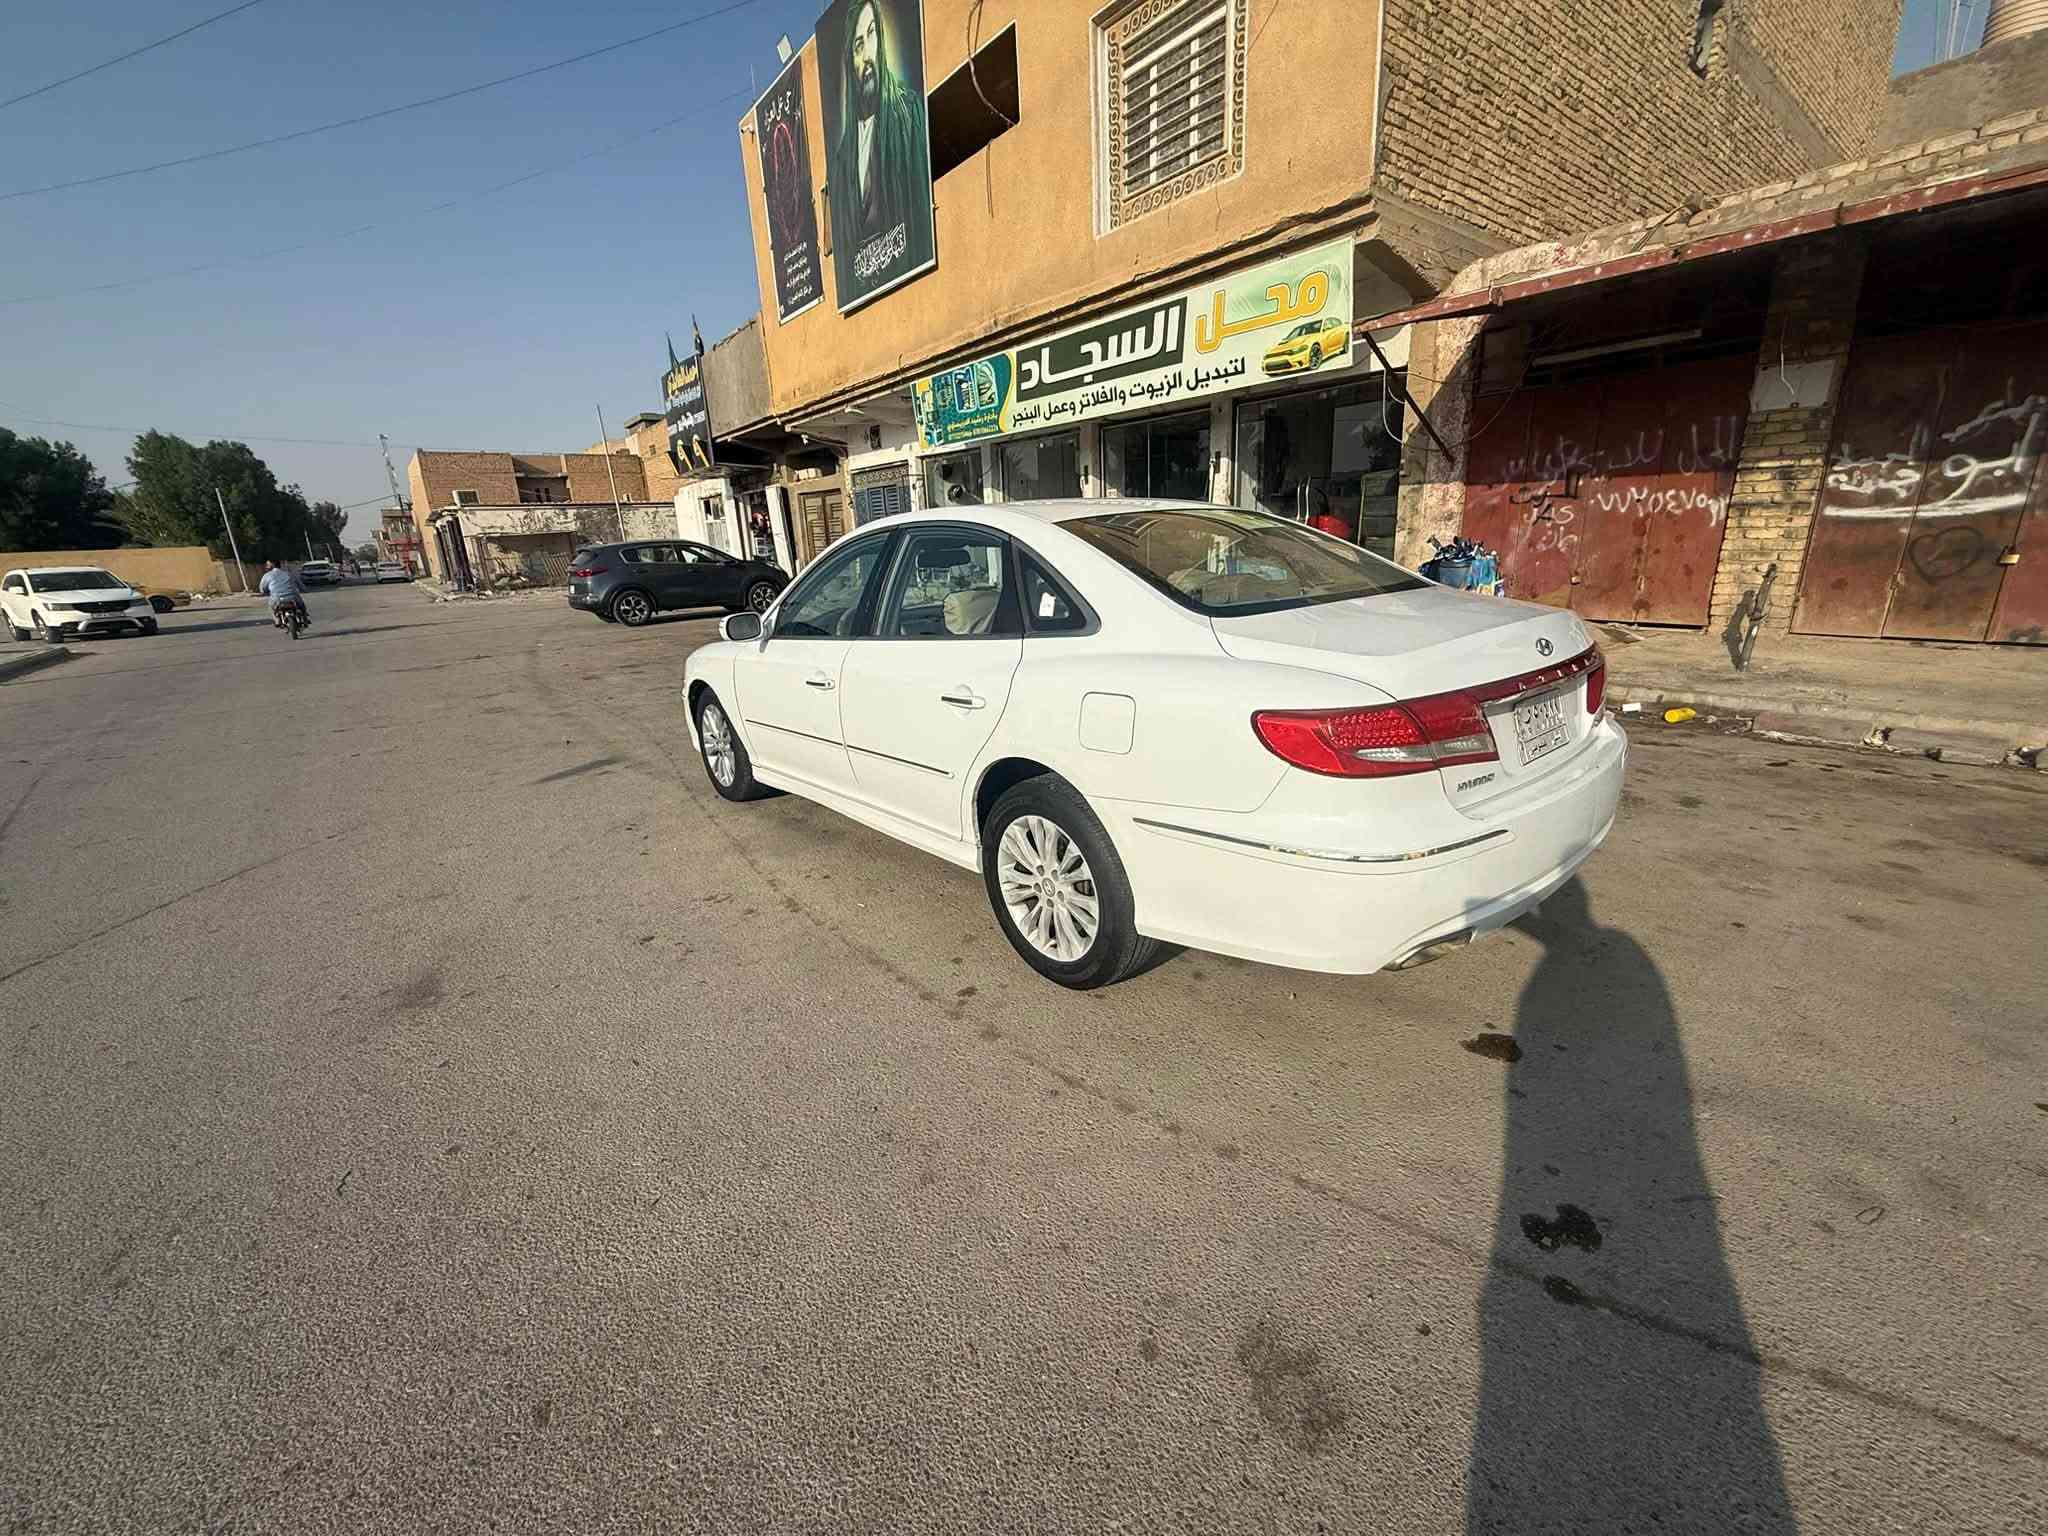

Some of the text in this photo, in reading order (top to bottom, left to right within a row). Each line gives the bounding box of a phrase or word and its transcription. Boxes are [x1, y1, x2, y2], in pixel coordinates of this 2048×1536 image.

[1020, 271, 1330, 391] محل السجاد
[1129, 370, 1183, 400] الزيوت
[1186, 356, 1246, 391] لتبديل
[1043, 401, 1076, 421] وعمل
[1079, 386, 1127, 415] والفلاتر
[1011, 405, 1042, 428] البنجر
